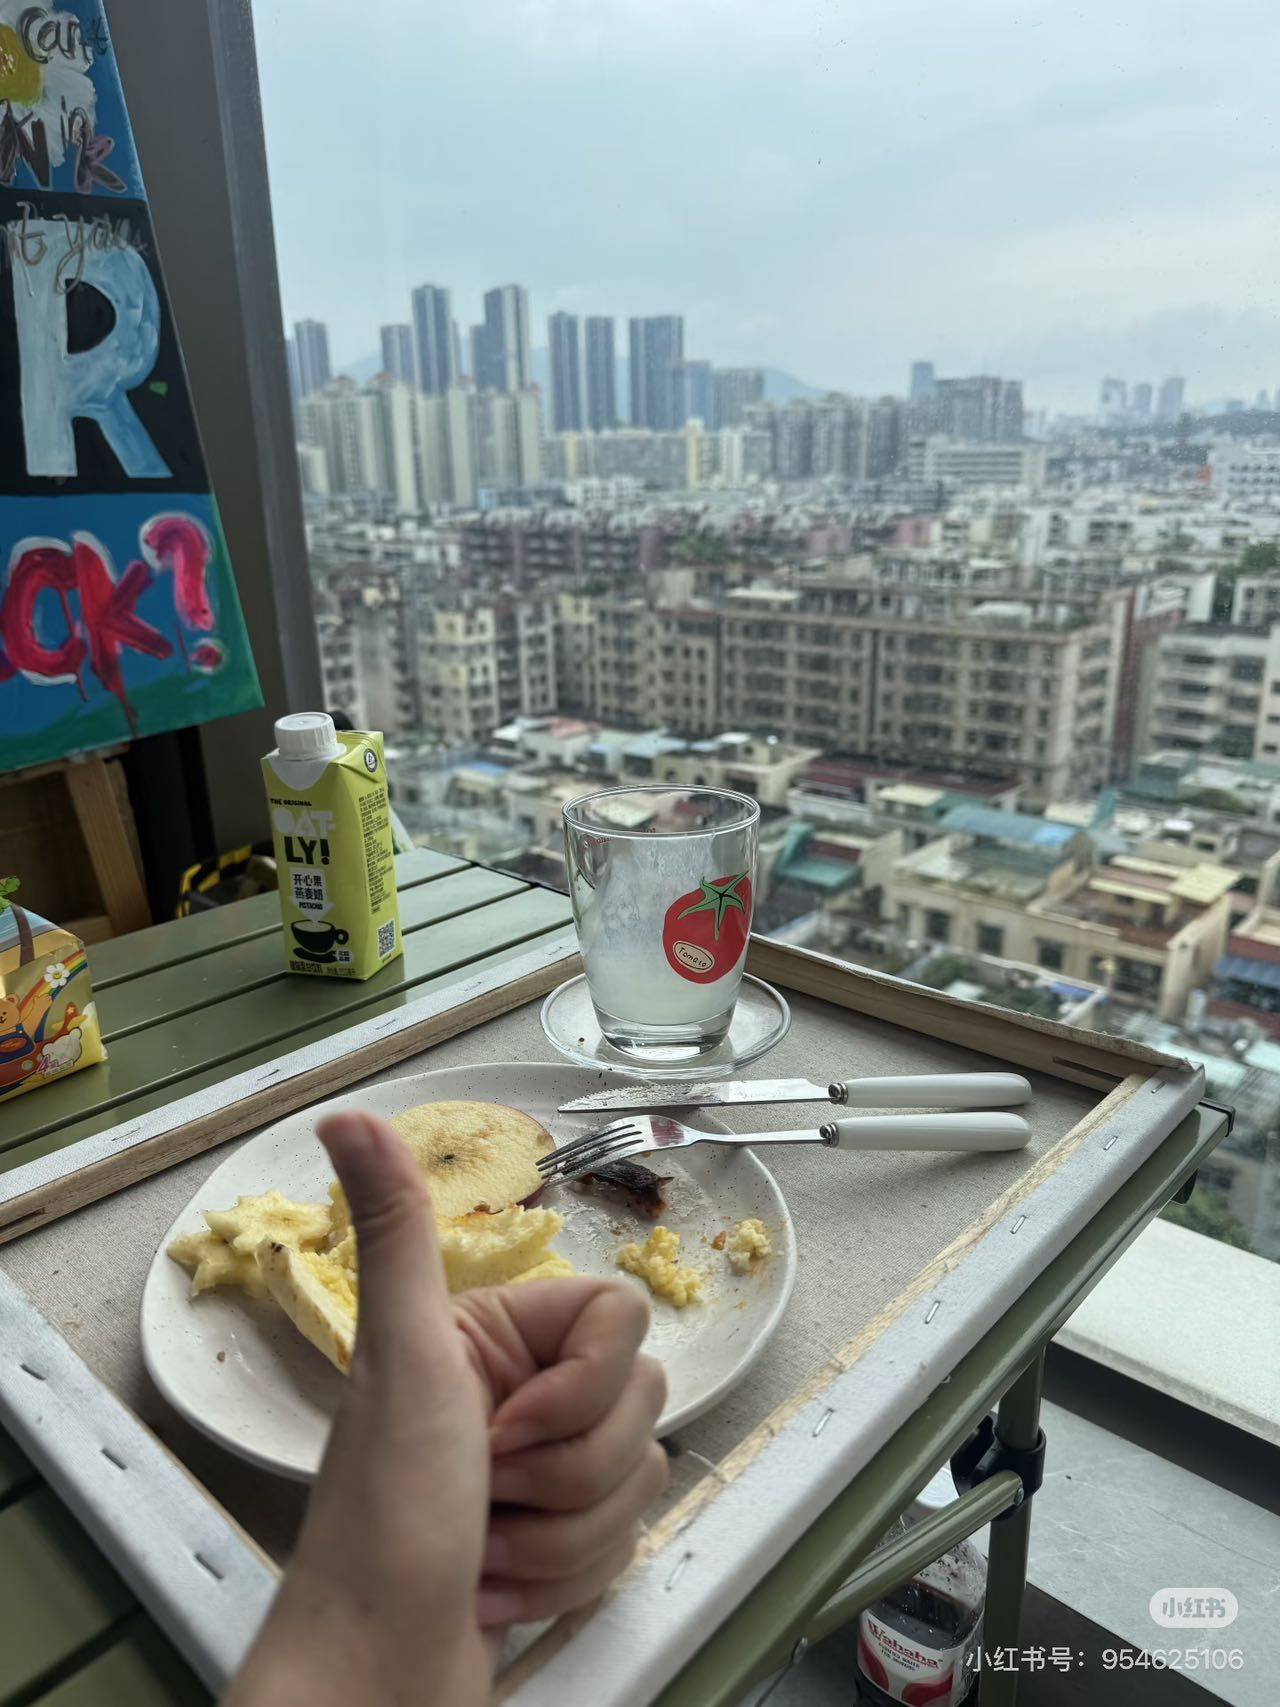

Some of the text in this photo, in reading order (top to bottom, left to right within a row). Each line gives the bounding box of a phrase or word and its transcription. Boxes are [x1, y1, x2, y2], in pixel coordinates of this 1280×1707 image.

[284, 836, 330, 865] LY!
[292, 873, 322, 887] 开心果
[678, 947, 706, 967] Tomato
[867, 1618, 940, 1669] Wahaha
